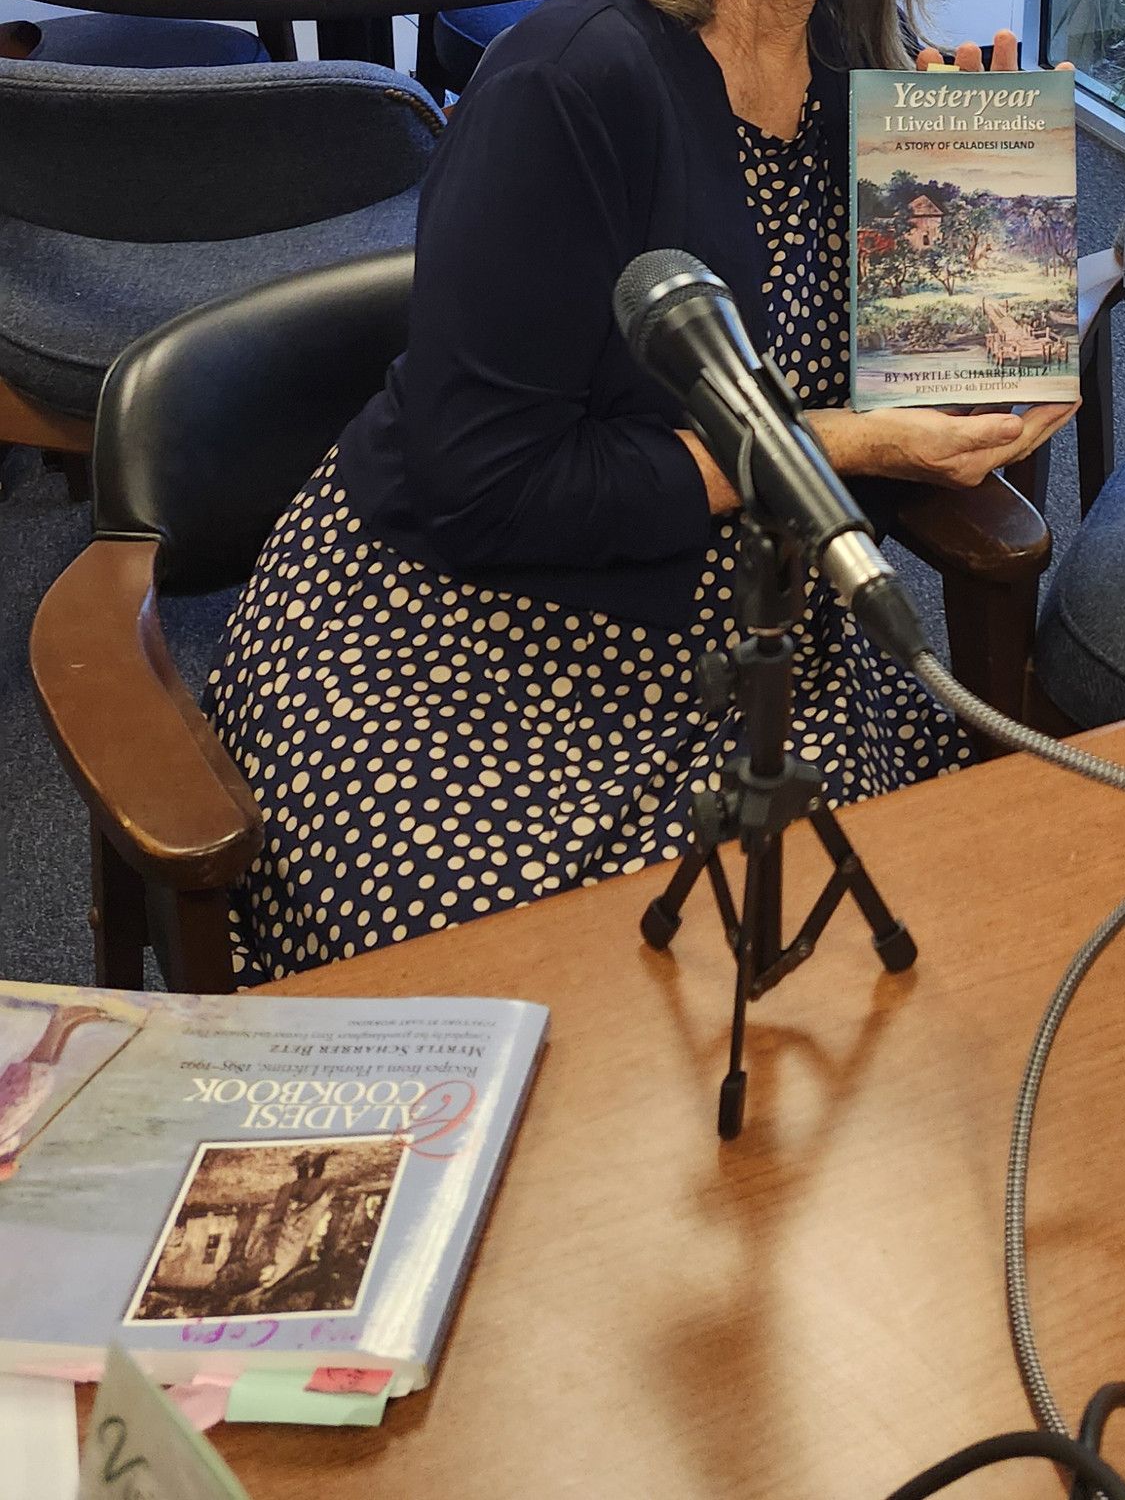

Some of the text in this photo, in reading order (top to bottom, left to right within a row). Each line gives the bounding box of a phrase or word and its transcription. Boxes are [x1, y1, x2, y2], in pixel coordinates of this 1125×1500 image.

[893, 82, 1041, 116] Yesteryear
[884, 115, 1046, 132] I Lived In Paradise
[895, 141, 1035, 151] A STORY OF CALADESI ISLAND
[884, 372, 900, 383] BY
[902, 370, 951, 382] MYRTLE
[916, 383, 962, 394] RENEWED
[979, 381, 1019, 391] EDITION
[269, 1044, 313, 1056] BETZ
[323, 1065, 373, 1078] Florida
[387, 1064, 421, 1078] from
[426, 1062, 478, 1078] Recipes
[183, 1078, 427, 1105] COOKBOOK
[239, 1080, 477, 1162] CALADESI
